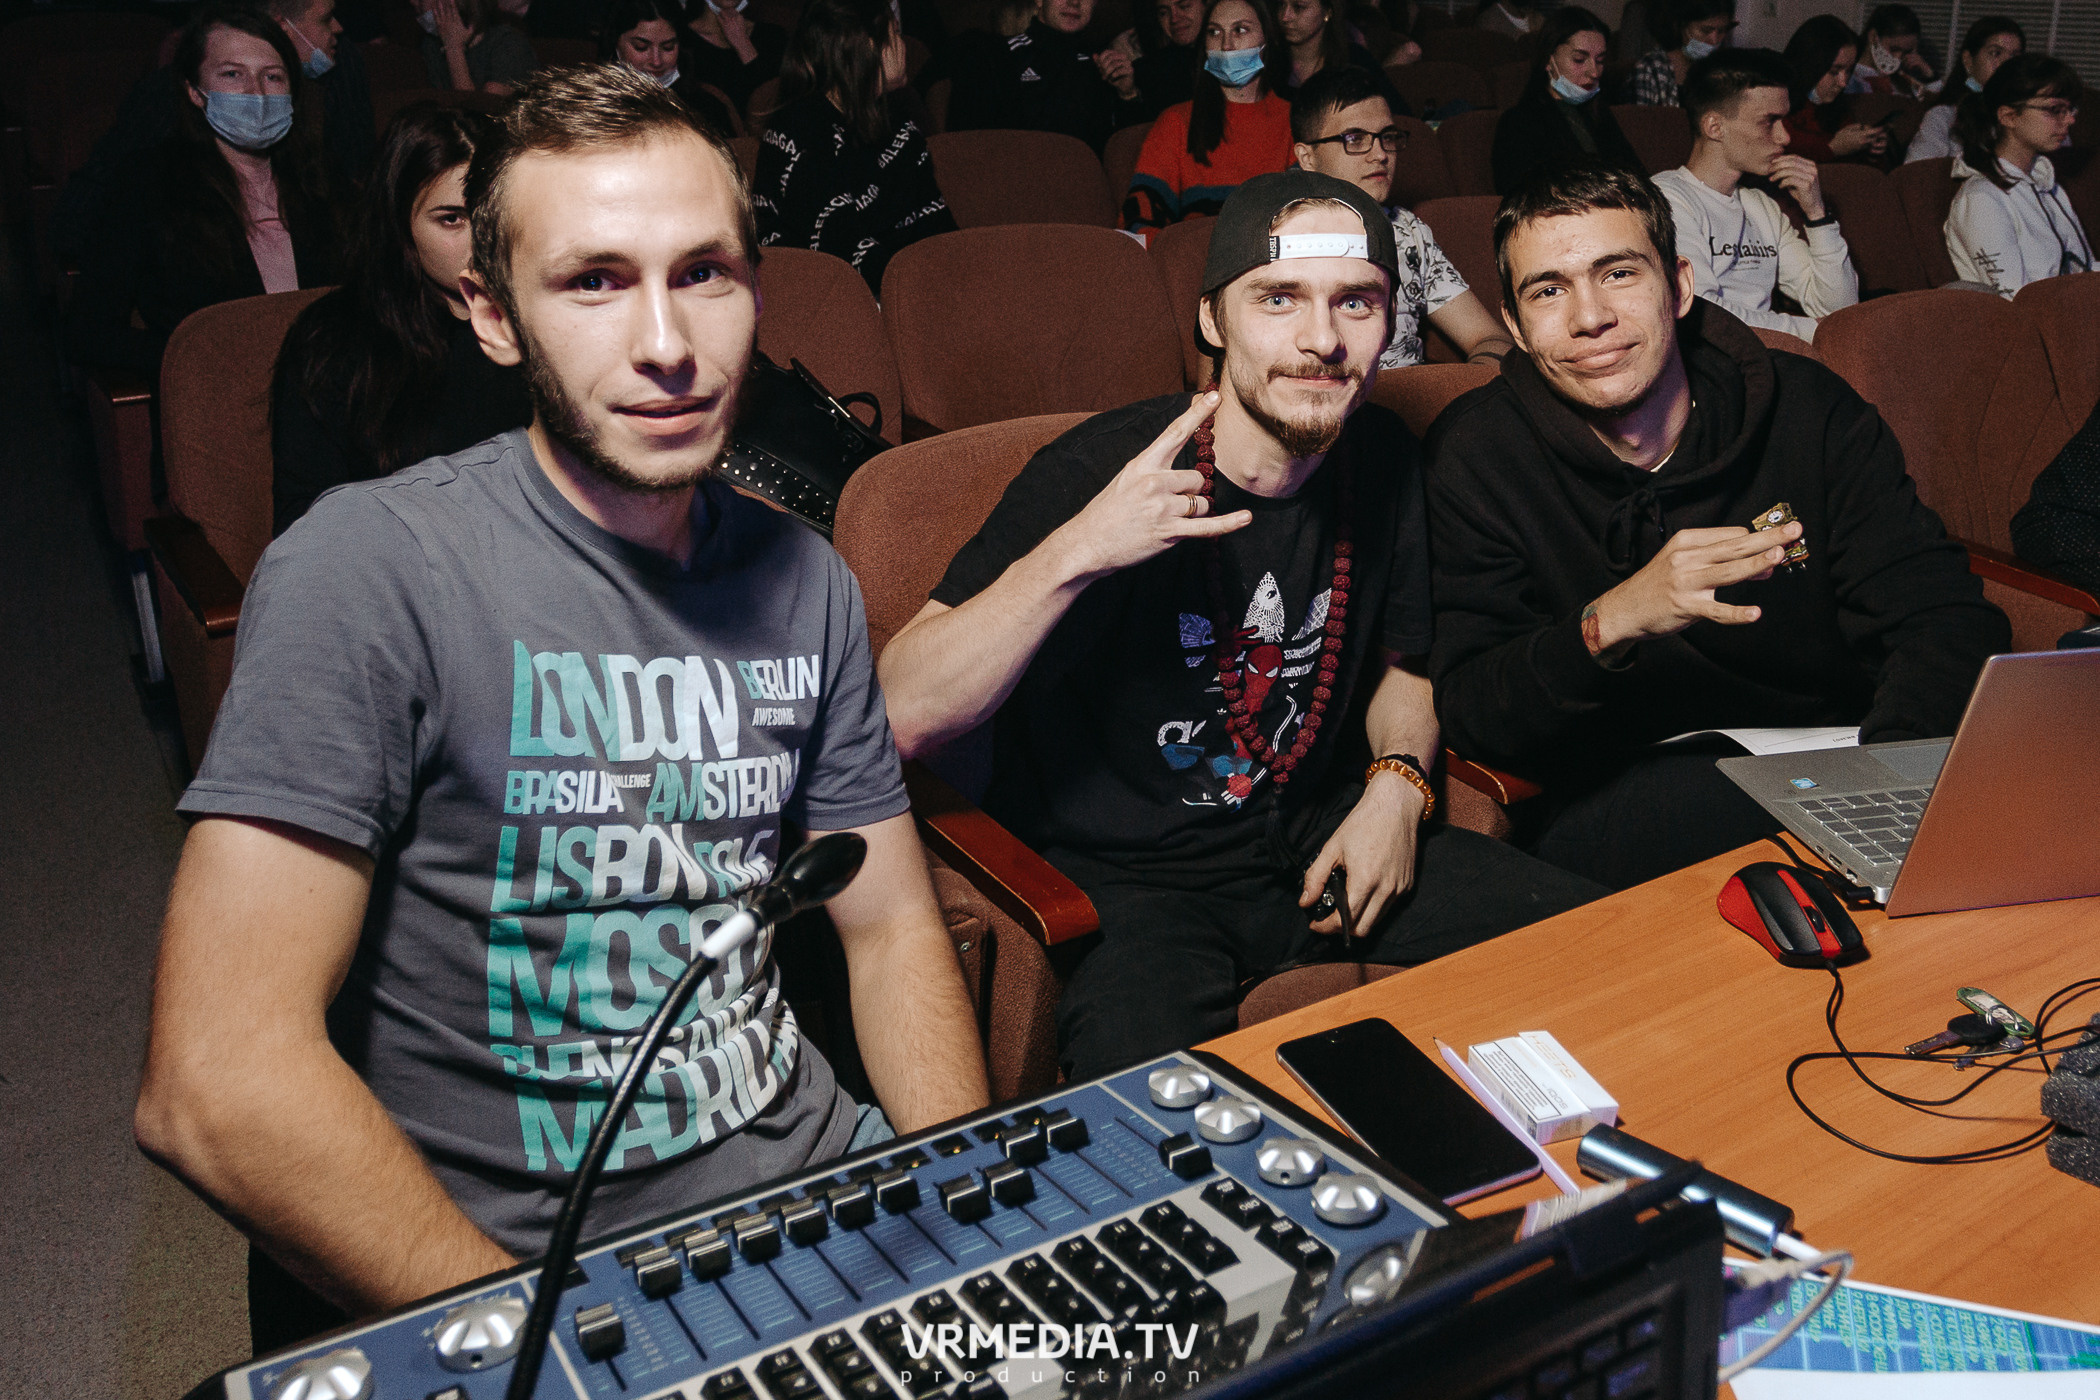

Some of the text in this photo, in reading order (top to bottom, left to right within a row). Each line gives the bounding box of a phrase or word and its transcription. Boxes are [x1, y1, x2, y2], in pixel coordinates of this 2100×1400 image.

[509, 639, 821, 762] LONDON BERLIN
[751, 706, 797, 727] AWESOME
[490, 822, 708, 913] LISBON
